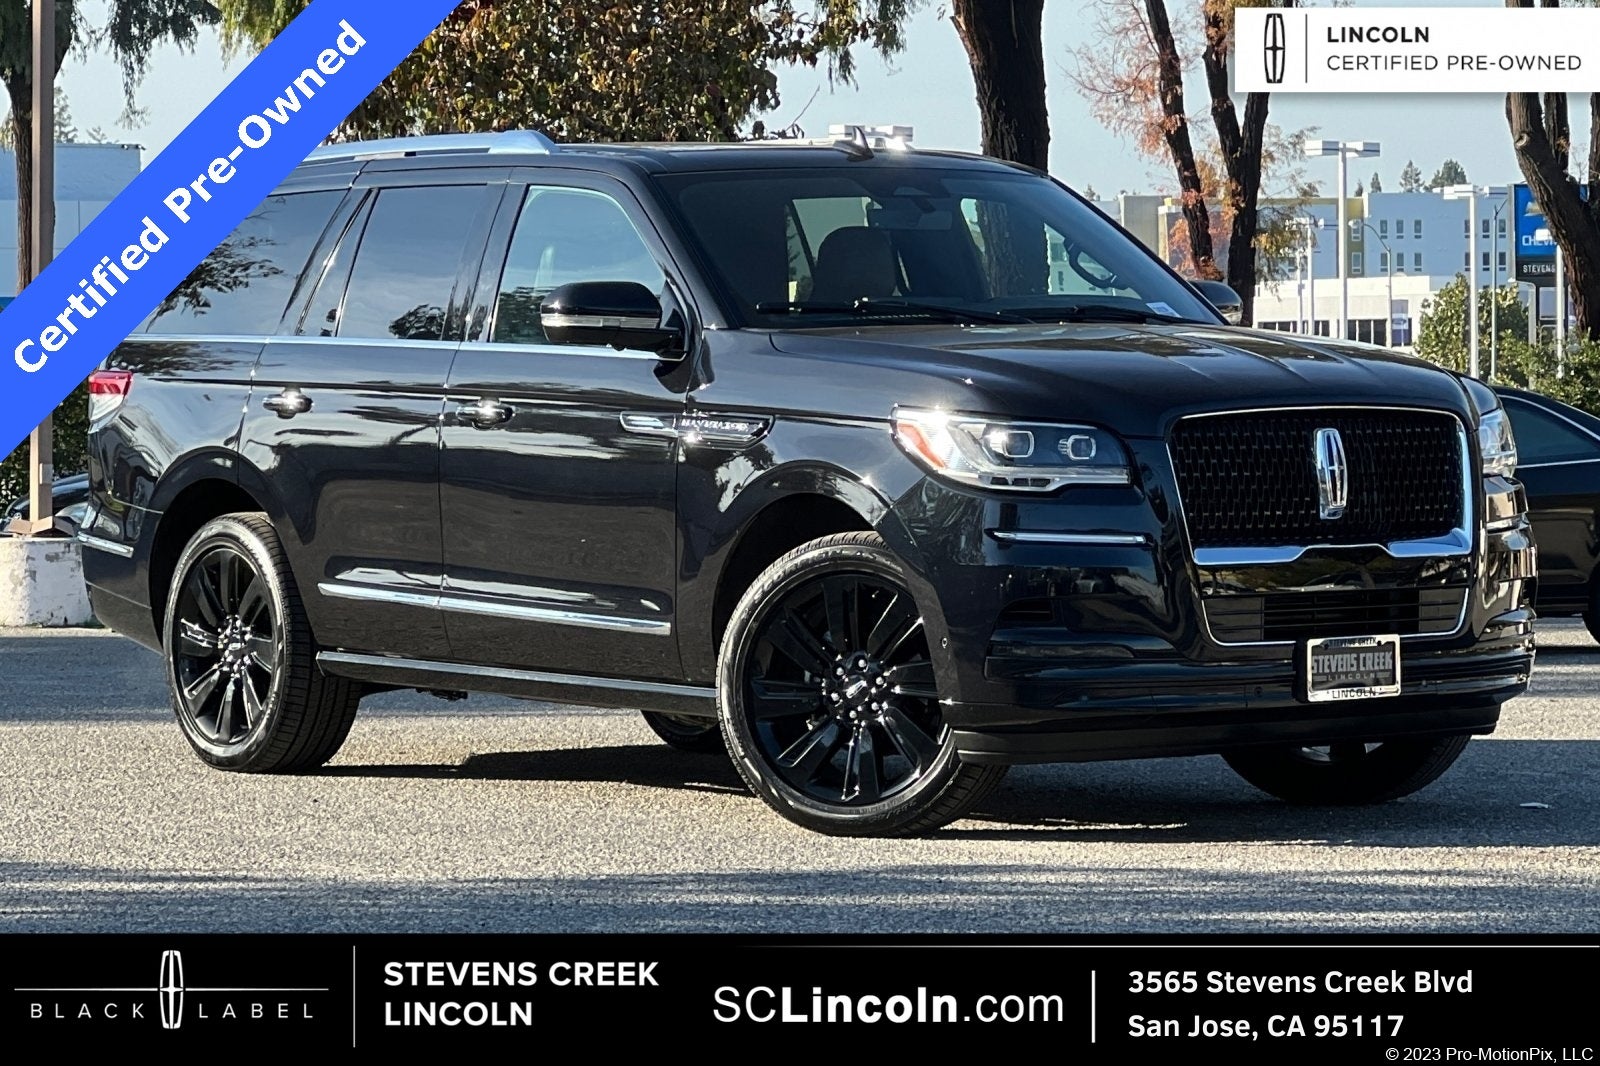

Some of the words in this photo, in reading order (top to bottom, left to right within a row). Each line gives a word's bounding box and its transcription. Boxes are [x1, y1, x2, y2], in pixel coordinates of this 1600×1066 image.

[1522, 264, 1556, 273] STEVENS
[1312, 653, 1358, 674] STEVENS
[1360, 651, 1393, 671] CREEK
[1328, 673, 1375, 681] LINCOLN
[1332, 687, 1376, 699] LINCOLN
